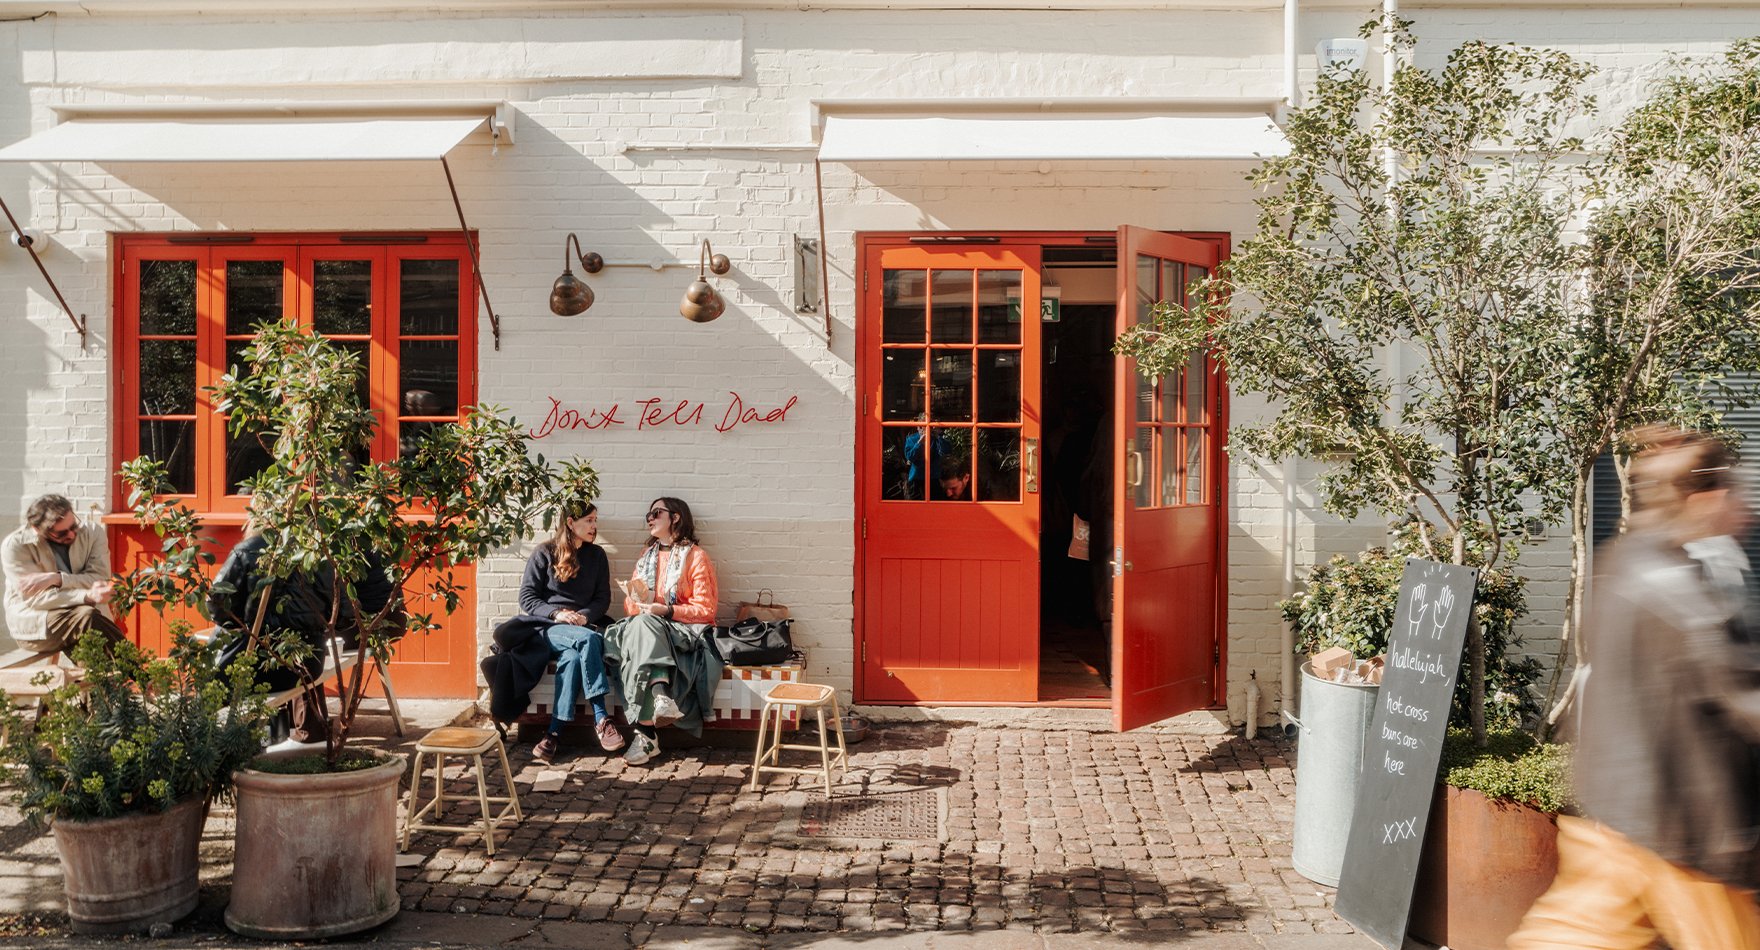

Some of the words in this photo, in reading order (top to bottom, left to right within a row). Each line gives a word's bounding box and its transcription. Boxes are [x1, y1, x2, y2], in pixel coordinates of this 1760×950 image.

[530, 395, 625, 439] Don't
[635, 397, 704, 431] Tell
[715, 391, 798, 433] Dad
[1391, 639, 1451, 687] hallelujah,
[1386, 691, 1403, 714] hot
[1404, 704, 1430, 722] cross
[1381, 721, 1402, 745] buns
[1402, 734, 1418, 750] are
[1384, 749, 1406, 776] here
